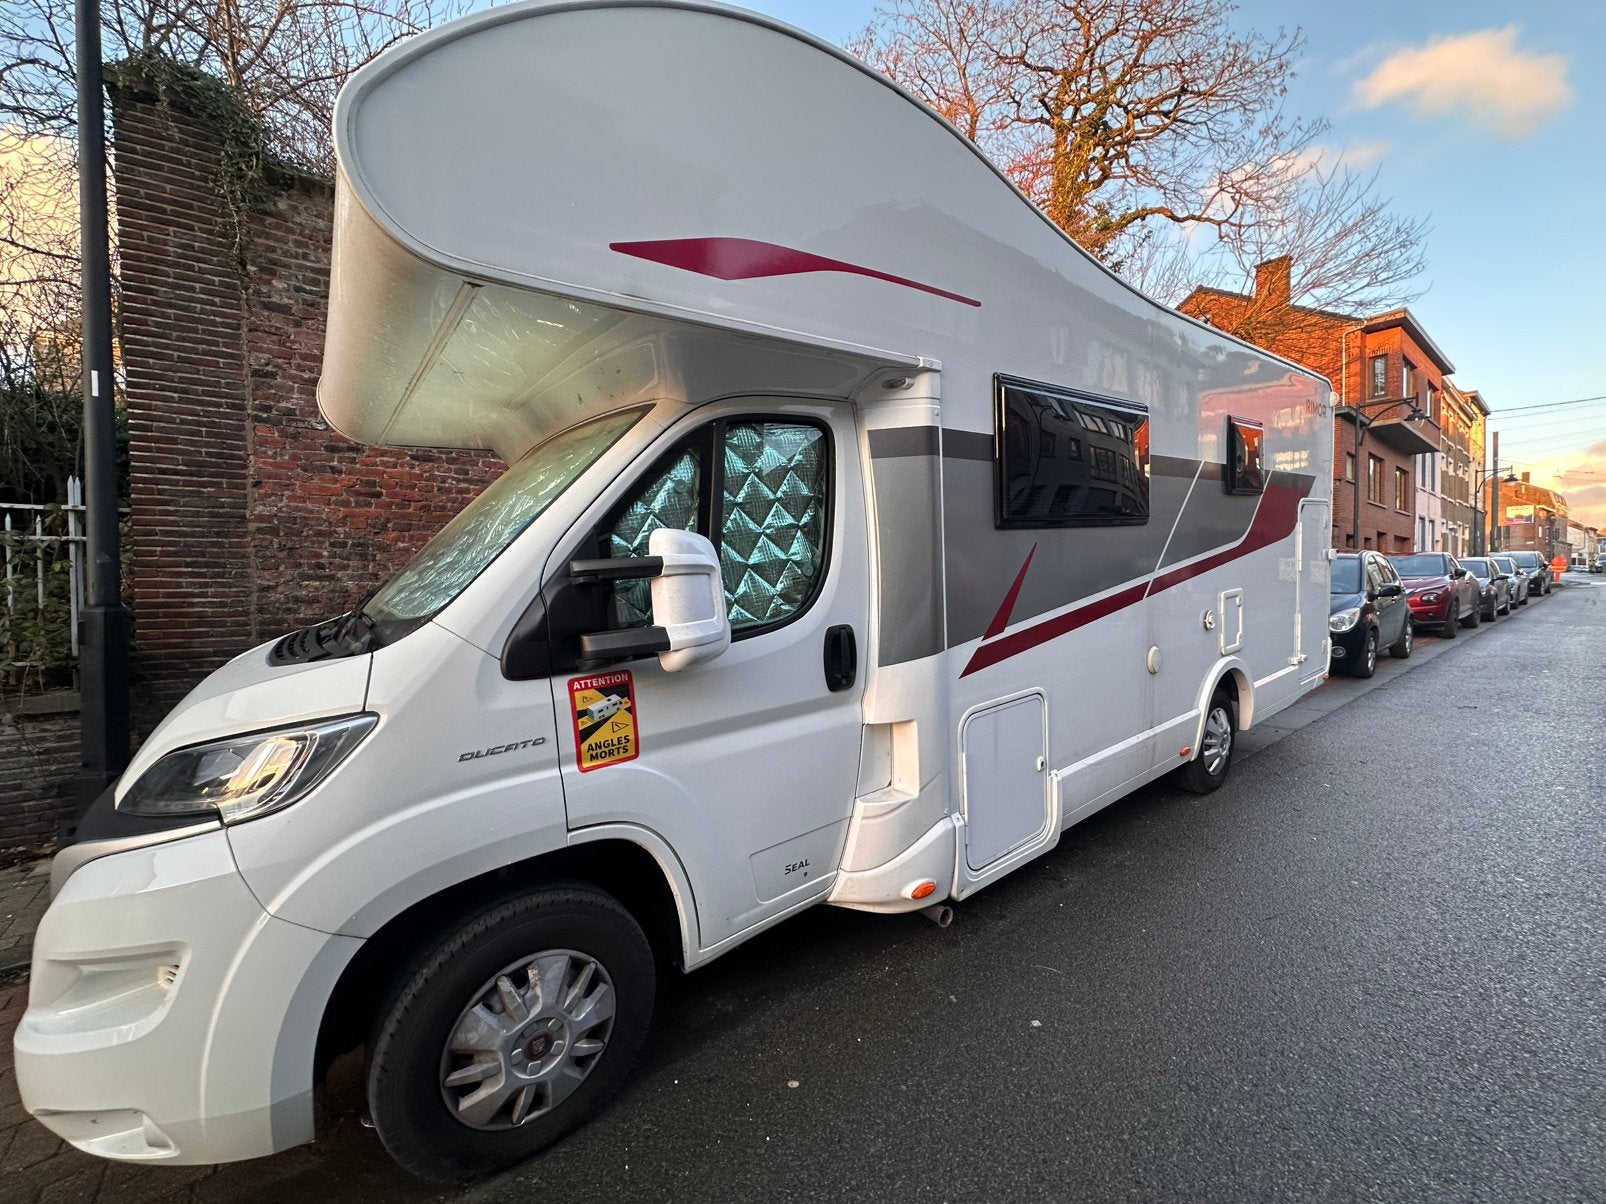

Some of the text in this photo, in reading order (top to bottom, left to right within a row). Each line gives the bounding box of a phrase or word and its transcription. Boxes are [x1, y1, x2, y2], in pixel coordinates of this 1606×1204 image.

[573, 673, 629, 690] ATTENTION
[457, 737, 546, 762] DUCATO
[586, 735, 630, 753] ANGLES
[589, 745, 629, 762] MORTS
[784, 859, 810, 875] SEAL
